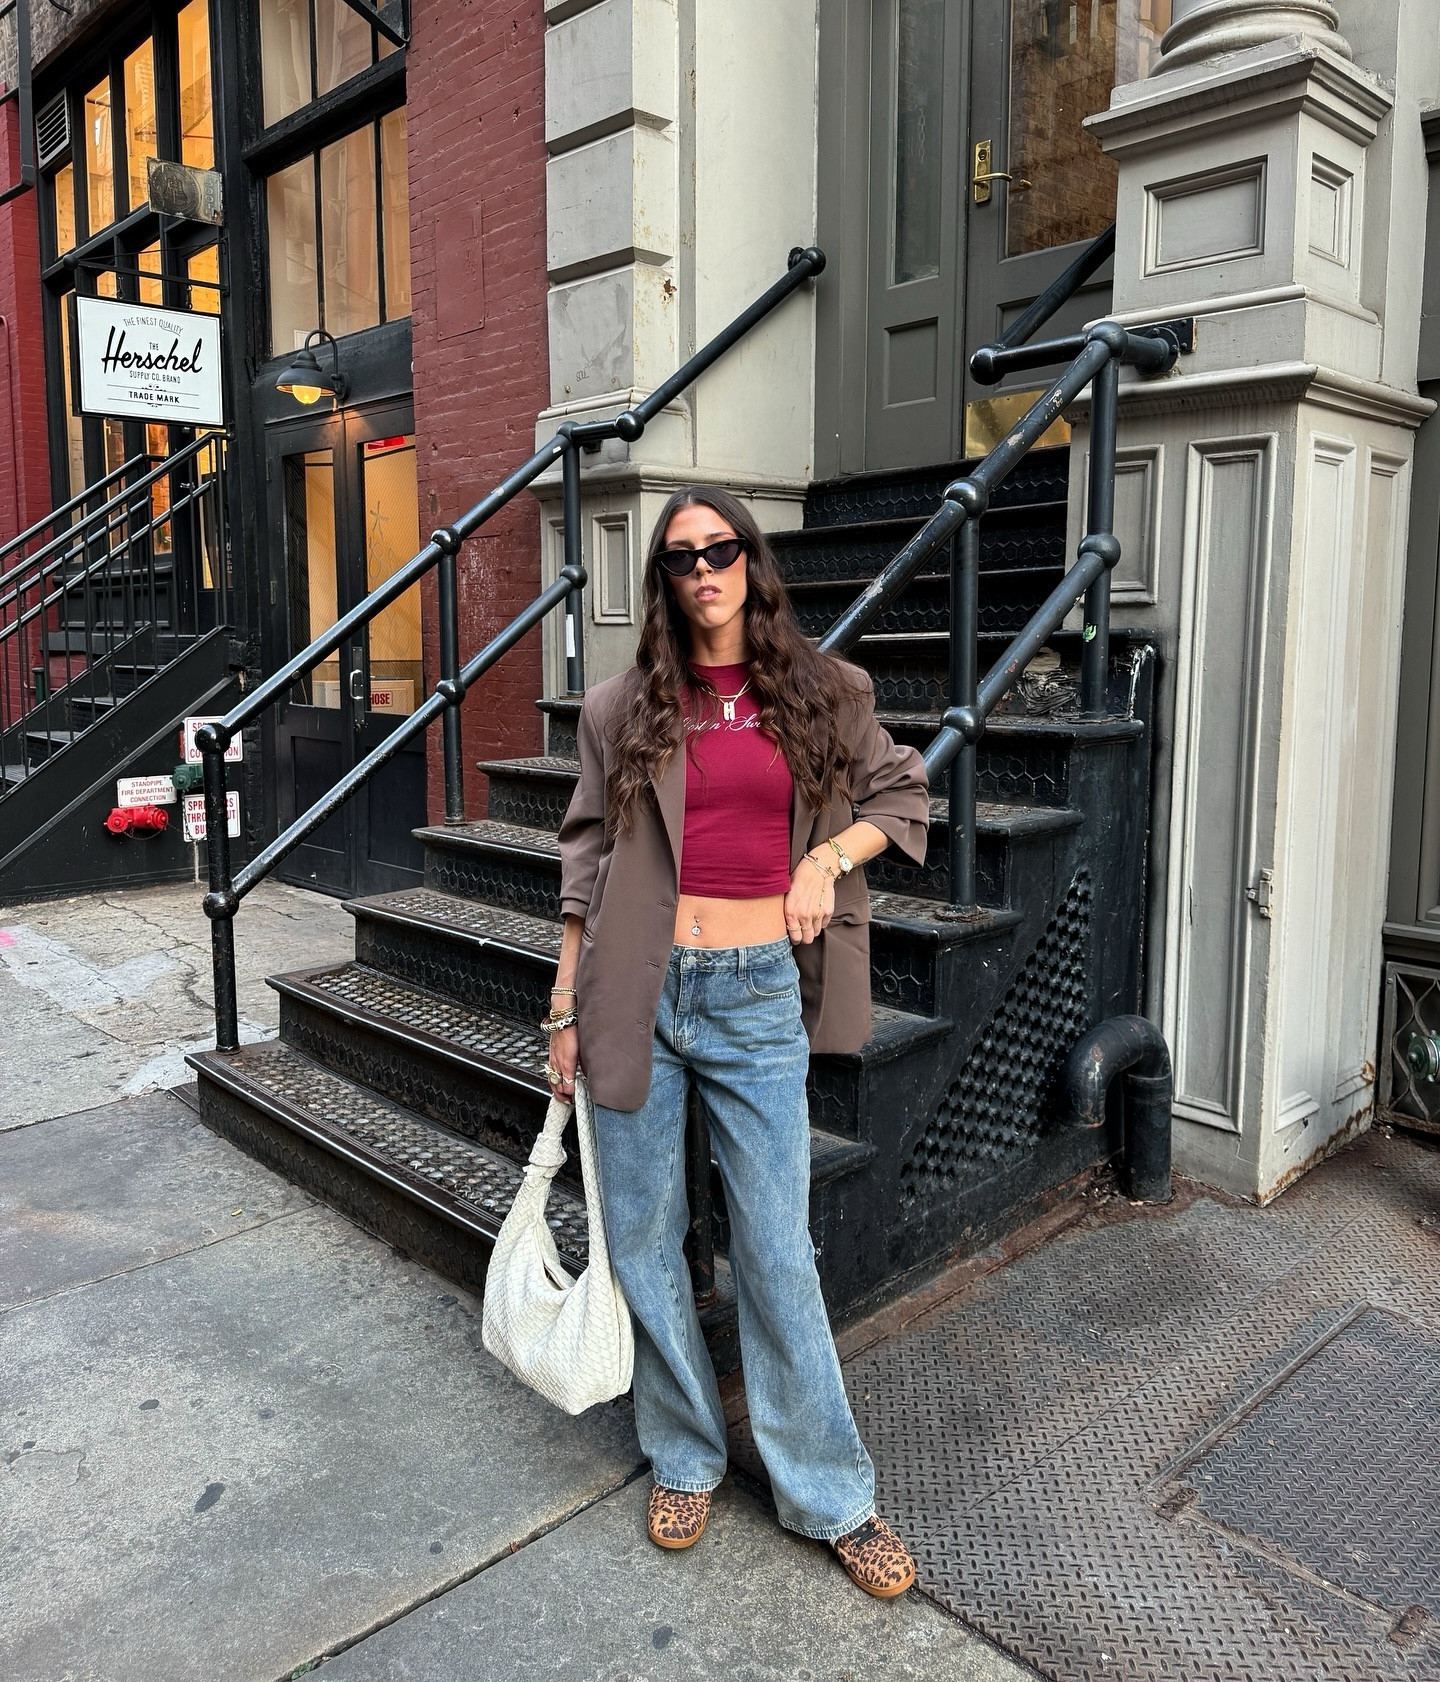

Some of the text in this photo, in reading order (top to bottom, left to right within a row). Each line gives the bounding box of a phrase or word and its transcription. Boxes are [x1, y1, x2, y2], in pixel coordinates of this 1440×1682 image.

[124, 316, 184, 336] THE FINEST QUALITY
[101, 325, 202, 374] Herschel
[149, 342, 159, 350] THE
[130, 370, 180, 384] SUPPLY CO. BRAND
[129, 391, 180, 403] TRADE MARK
[136, 787, 173, 795] DEPARTMENT
